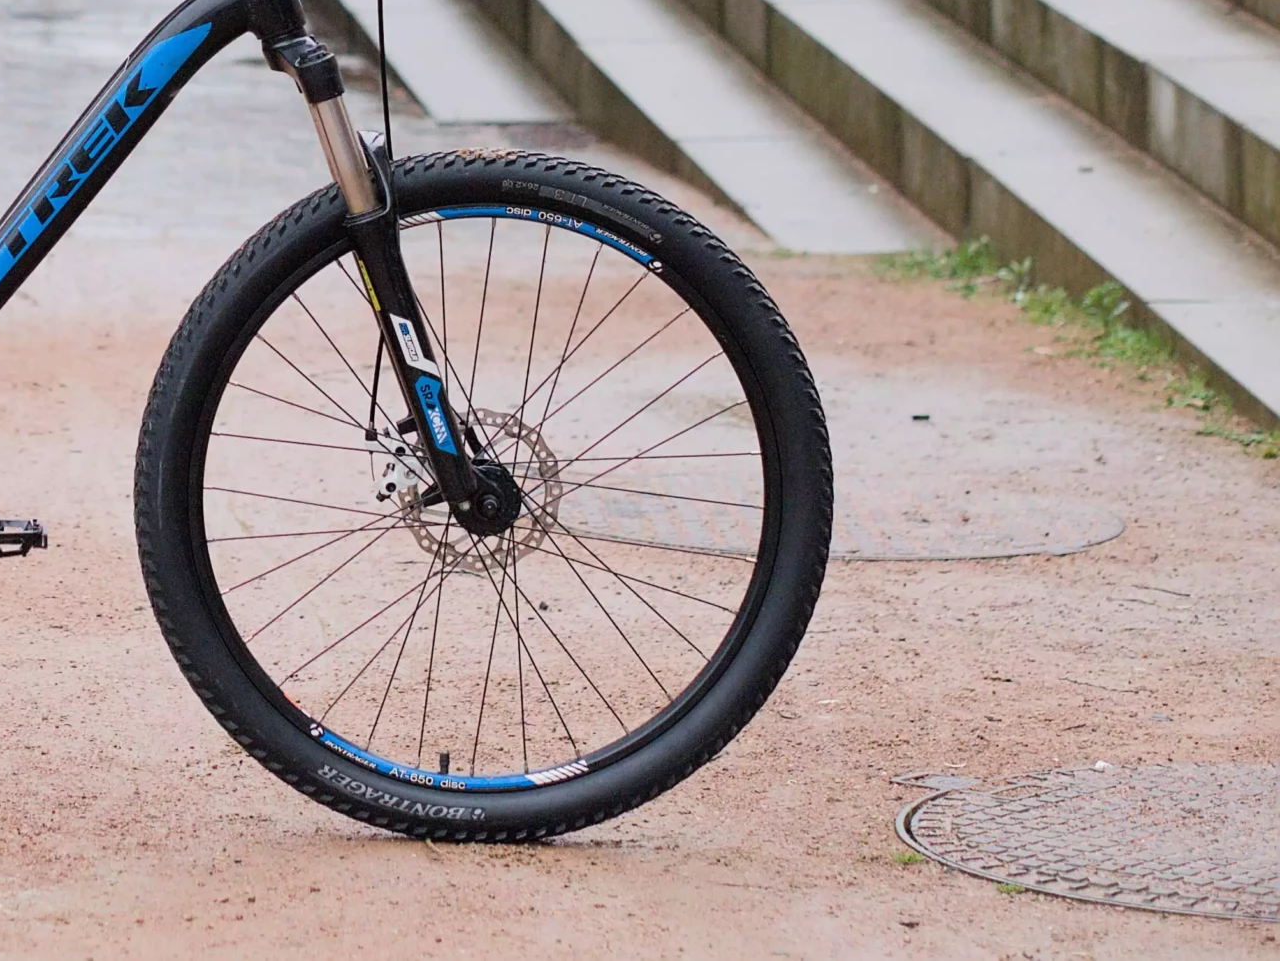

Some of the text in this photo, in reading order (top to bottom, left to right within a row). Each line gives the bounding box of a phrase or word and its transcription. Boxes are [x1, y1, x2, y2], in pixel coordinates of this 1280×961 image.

[554, 189, 566, 200] 3
[571, 193, 588, 207] LT
[506, 206, 648, 257] BONTRAGER AT-650 disc
[428, 407, 448, 444] XCM
[324, 739, 466, 790] BONTRAGER AT-650 disc
[317, 763, 466, 820] BONTRAGER
